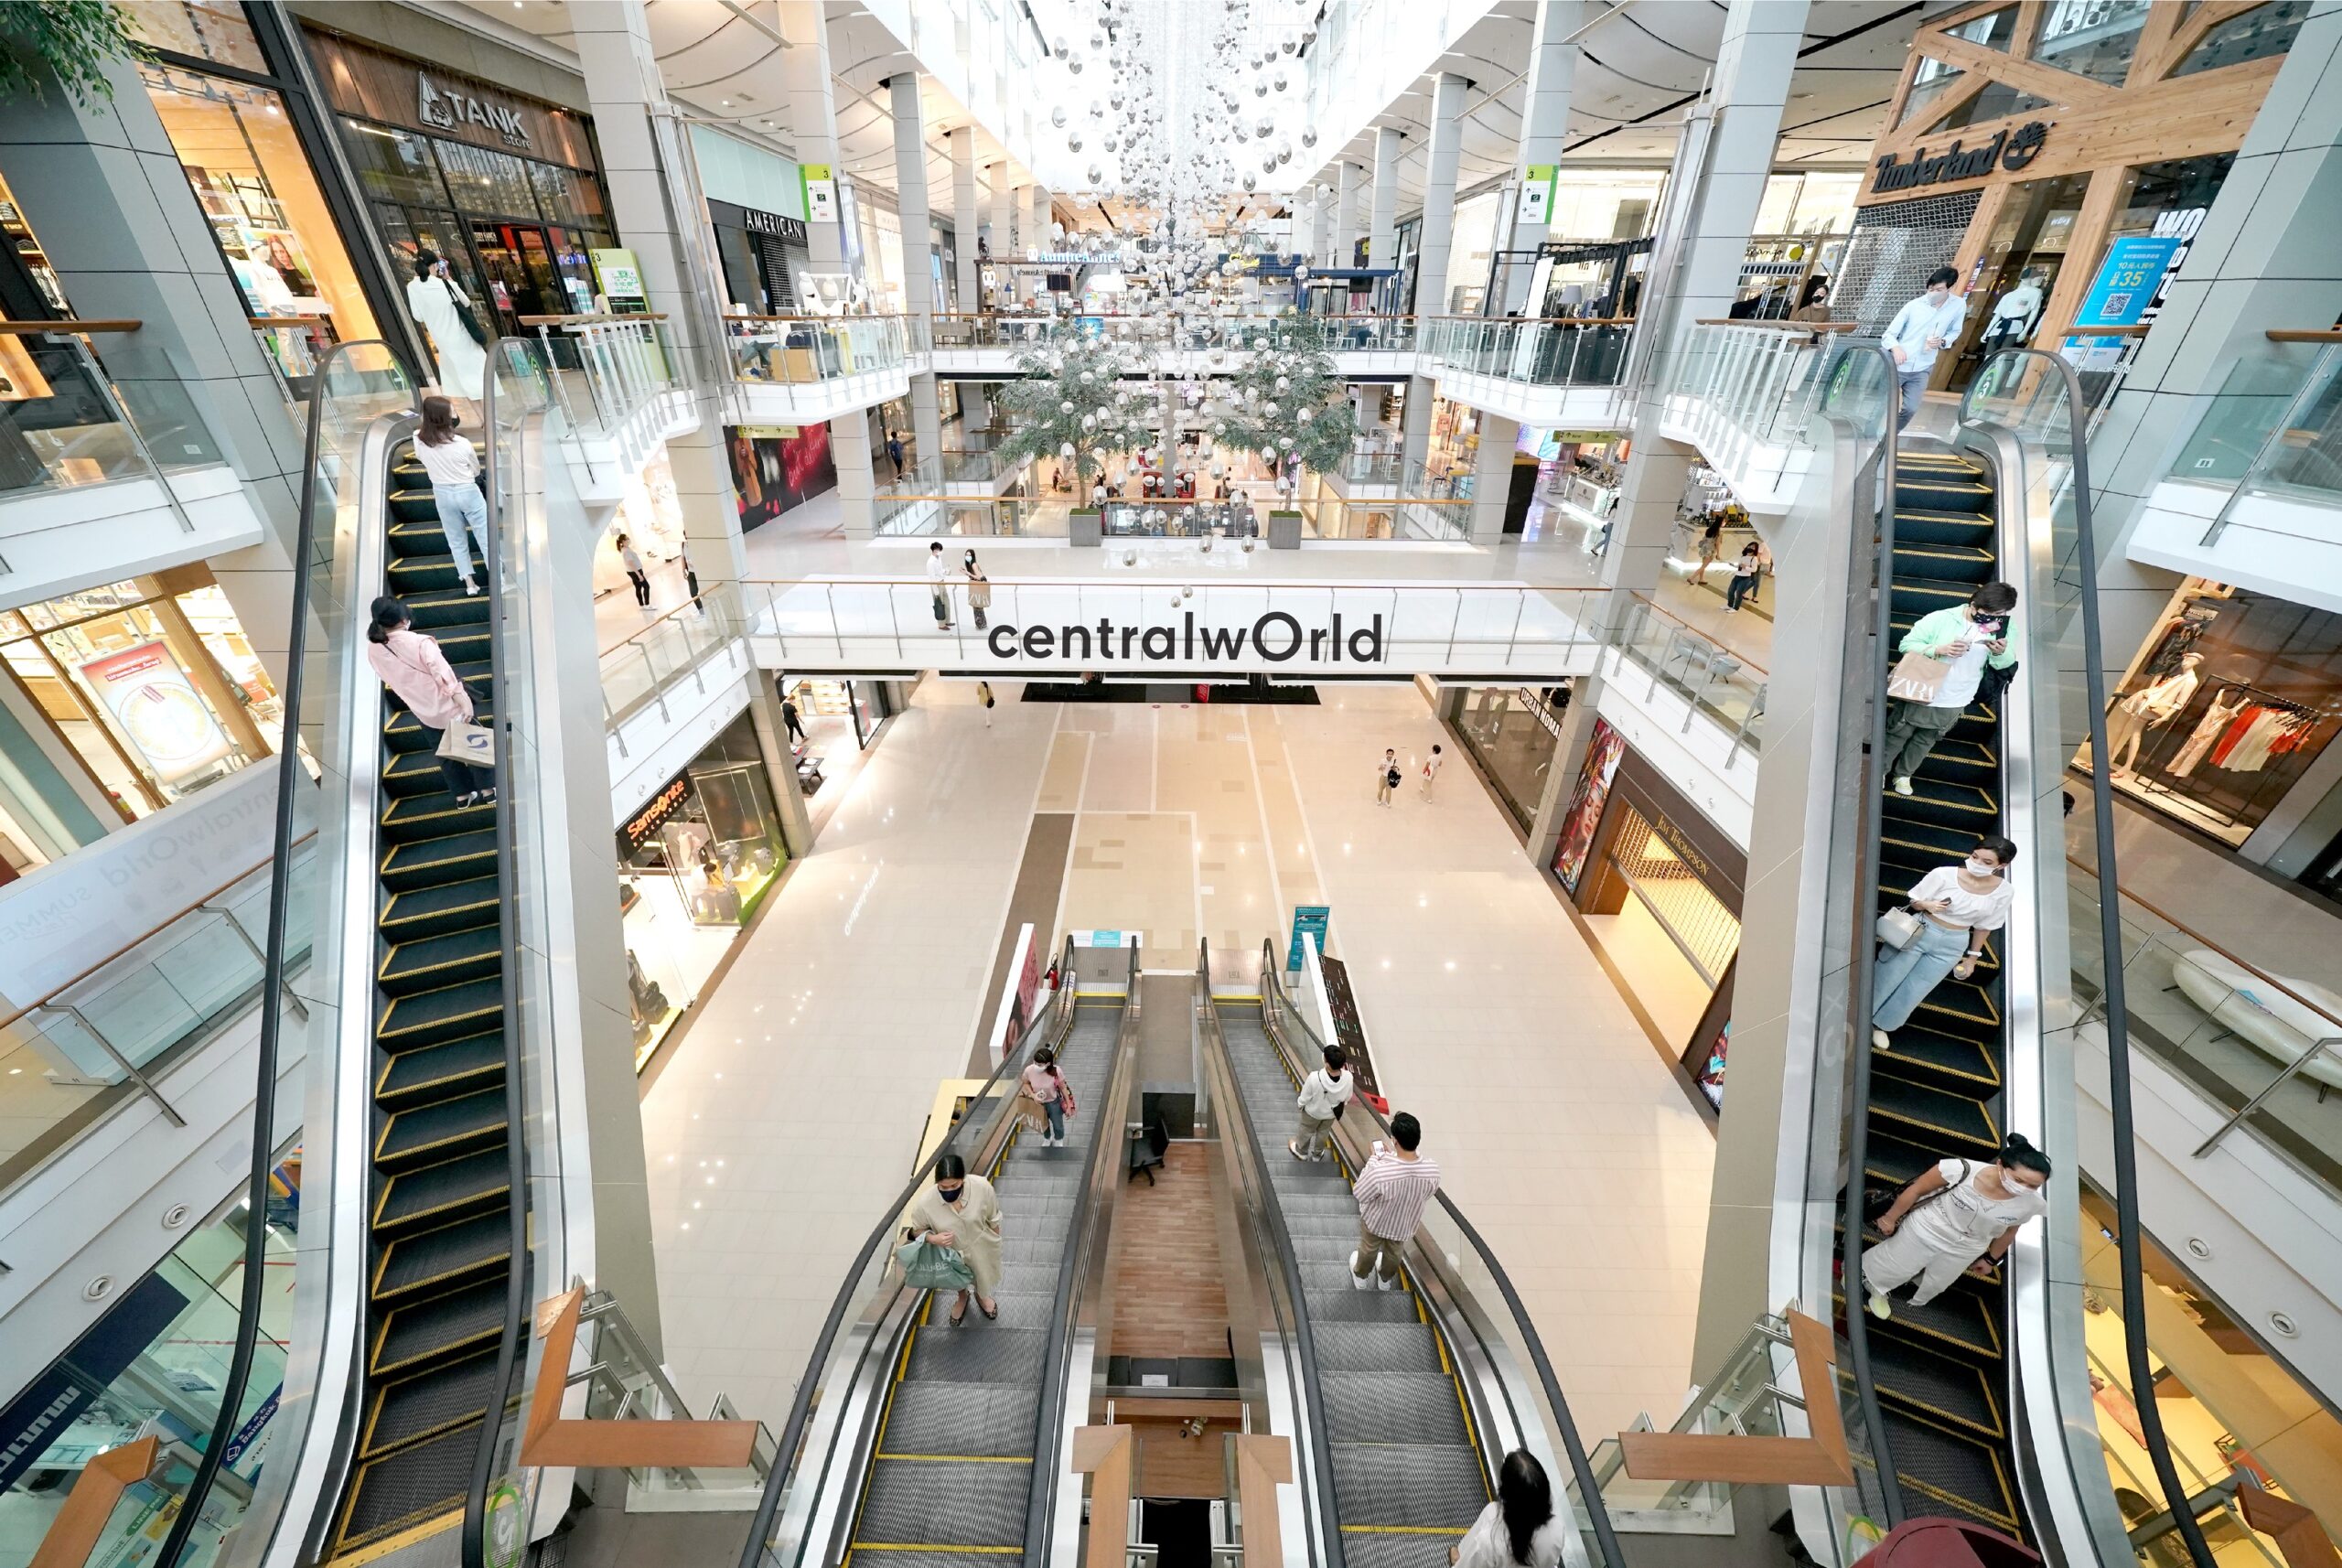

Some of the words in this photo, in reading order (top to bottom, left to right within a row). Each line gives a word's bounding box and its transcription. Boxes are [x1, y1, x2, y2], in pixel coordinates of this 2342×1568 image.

[443, 91, 529, 137] TANK
[503, 134, 532, 149] store
[823, 170, 829, 178] 3
[1528, 170, 1534, 179] 3
[1870, 129, 2008, 194] Timberland
[746, 209, 801, 238] AMERICAN
[595, 252, 601, 262] 3
[2119, 271, 2144, 287] 35
[988, 611, 1382, 662] centralwOrld
[1520, 688, 1542, 718] URBAN
[1654, 814, 1671, 835] JIM
[1671, 826, 1710, 875] THOMPSON
